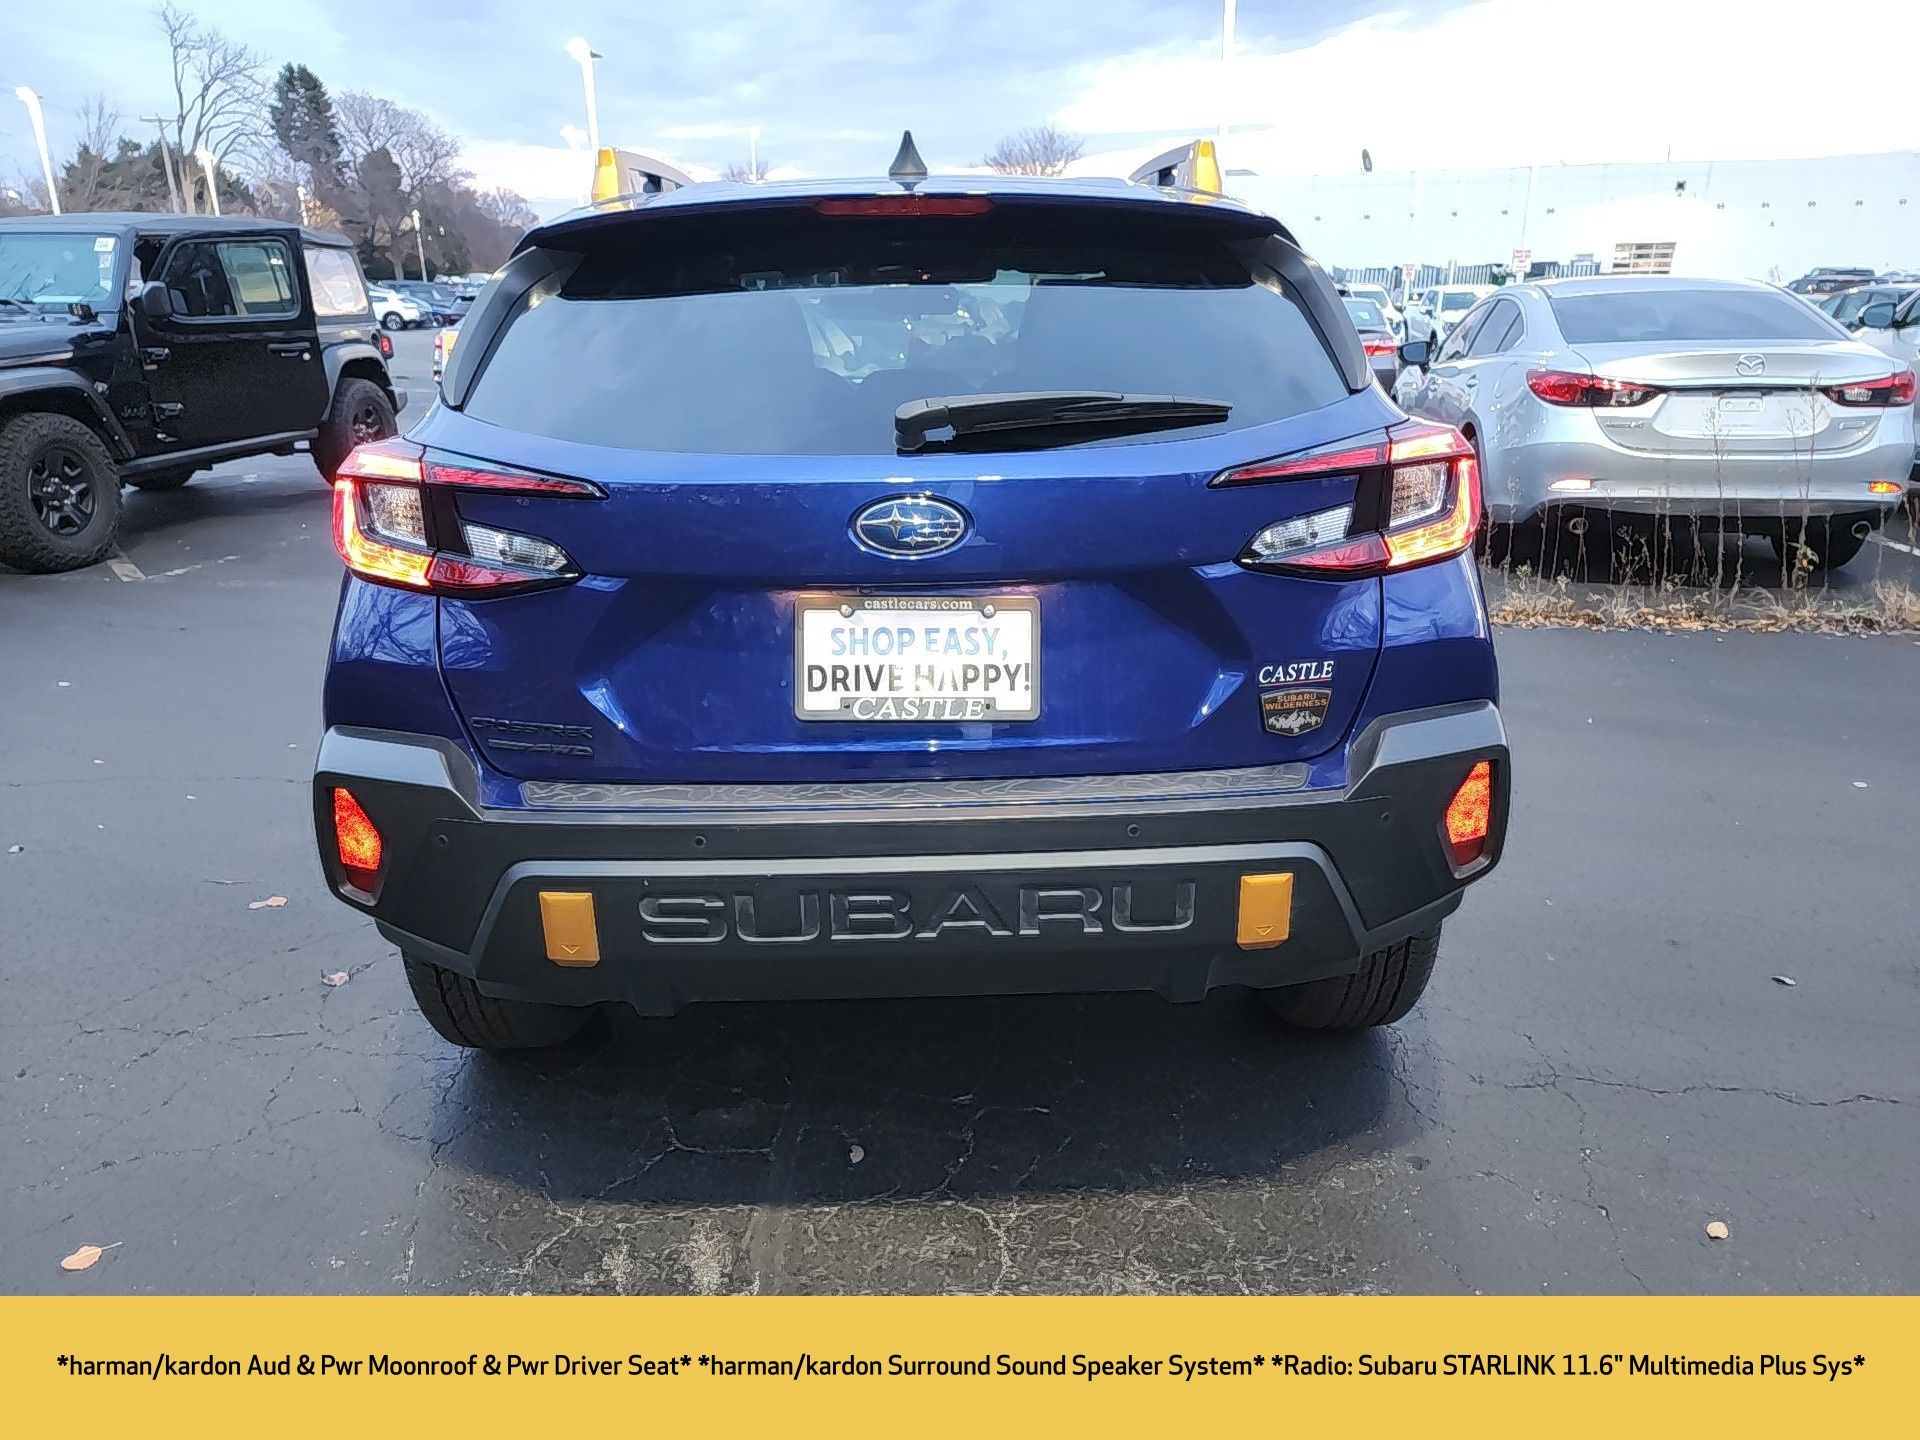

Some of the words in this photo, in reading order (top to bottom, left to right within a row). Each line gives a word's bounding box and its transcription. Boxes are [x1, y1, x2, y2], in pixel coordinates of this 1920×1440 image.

[864, 598, 974, 611] castlecars.com
[830, 626, 916, 656] SHOP
[924, 626, 1008, 660] EASY,
[807, 664, 904, 693] DRIVE
[914, 662, 1031, 693] HAPPY!
[1258, 660, 1334, 684] CASTLE
[852, 697, 986, 720] CASTLE
[1265, 698, 1328, 711] WILDERNESS
[1276, 692, 1317, 703] SUBARU
[637, 882, 1196, 943] SUBARU
